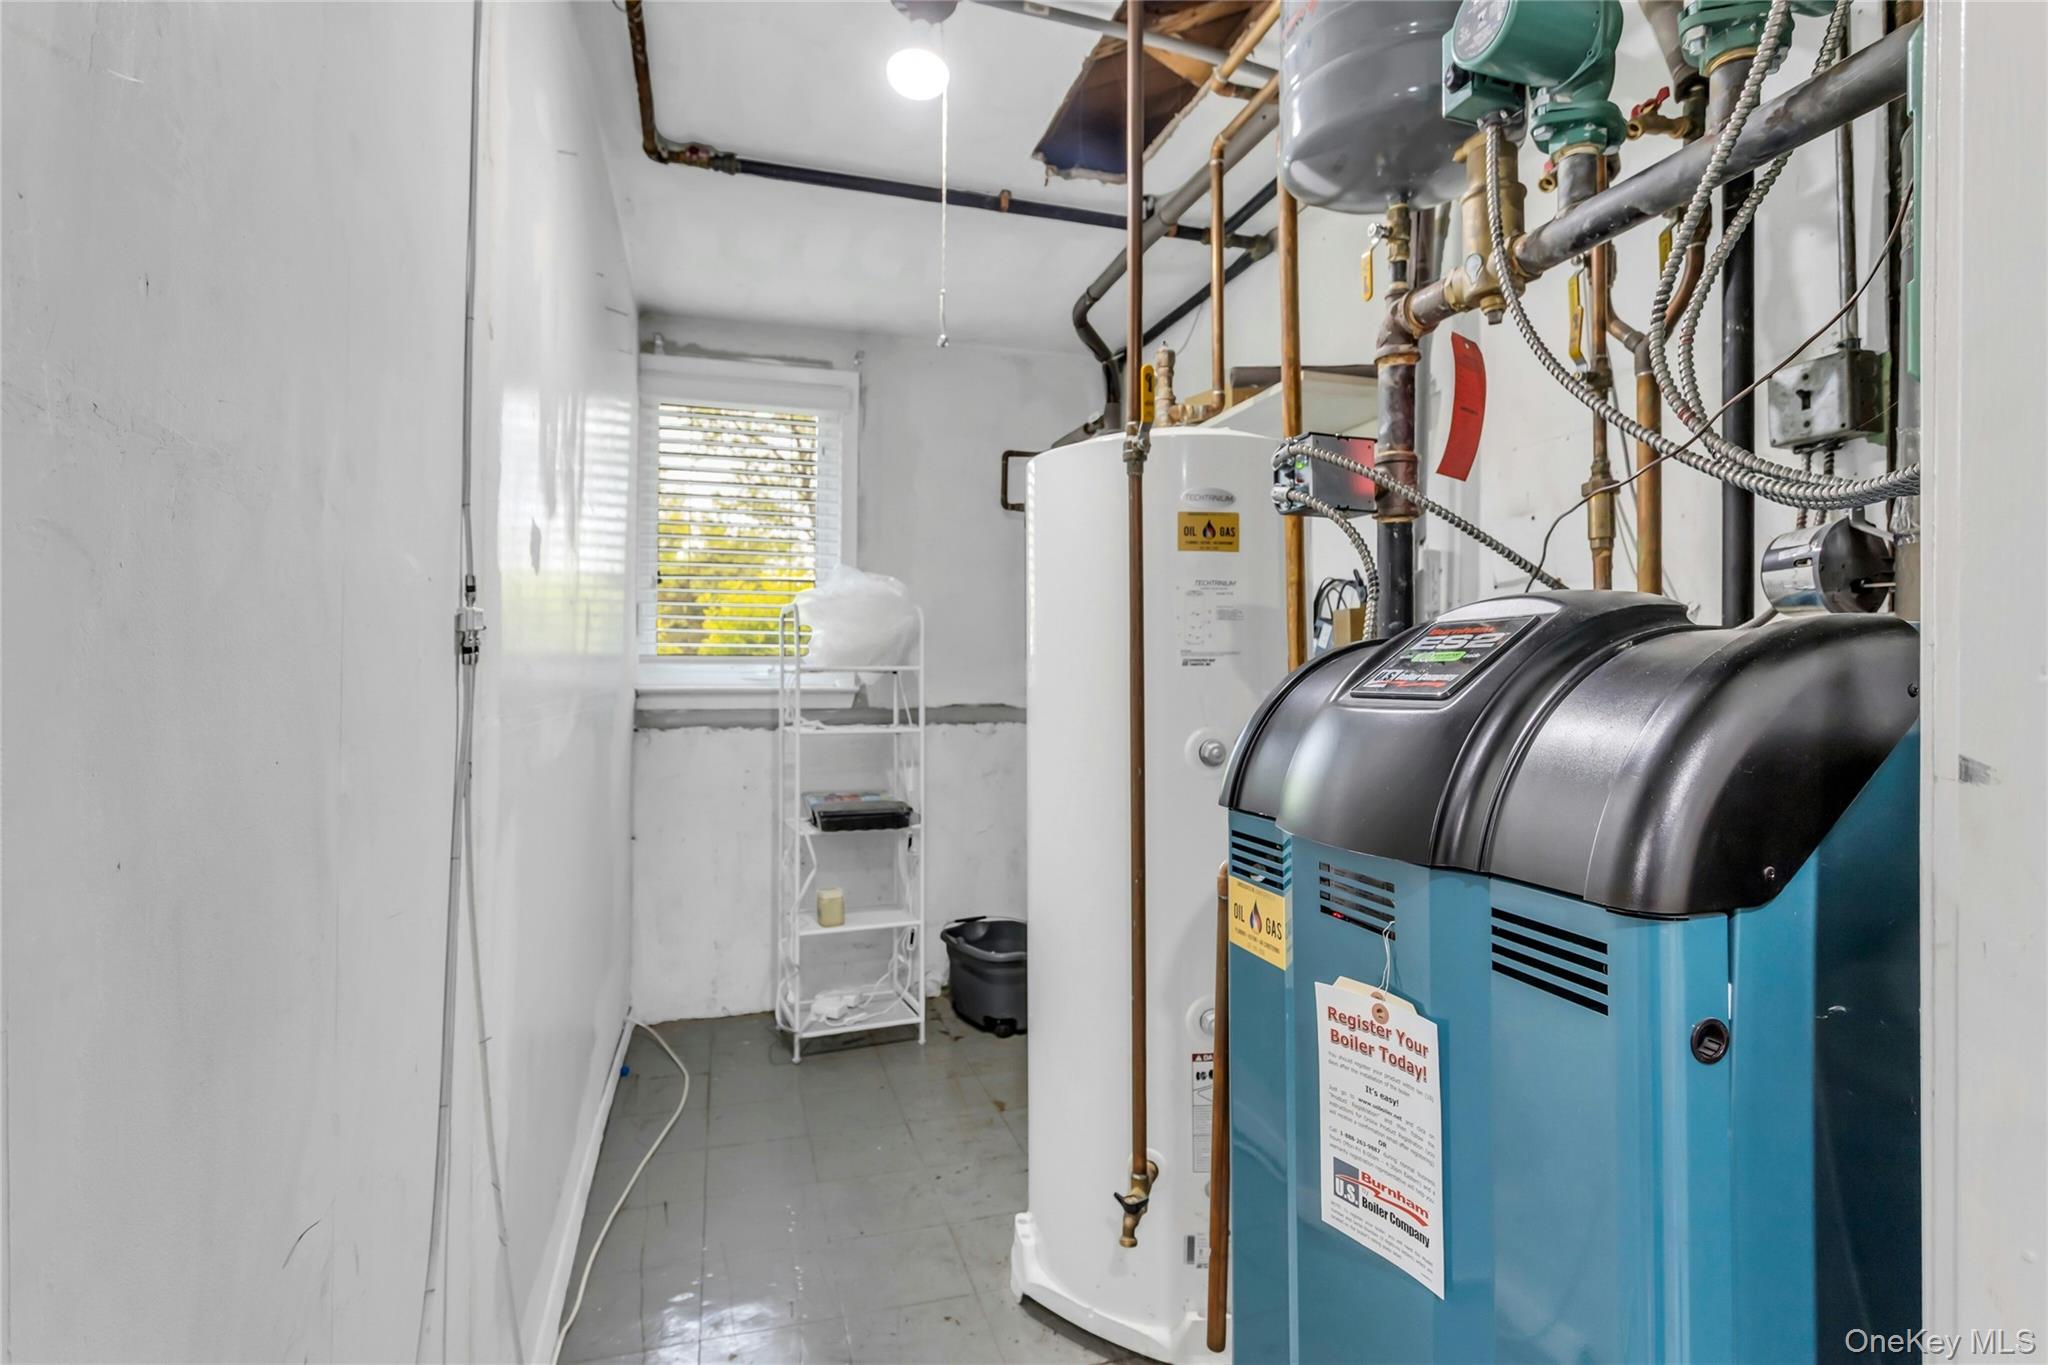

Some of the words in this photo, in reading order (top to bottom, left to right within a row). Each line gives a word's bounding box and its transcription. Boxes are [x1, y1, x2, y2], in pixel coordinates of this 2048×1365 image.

[1183, 526, 1197, 537] OIL
[1219, 526, 1236, 538] GAS
[1410, 632, 1506, 651] ES2
[1233, 902, 1245, 923] OIL
[1265, 917, 1283, 941] GAS
[1328, 1006, 1392, 1039] Register
[1396, 1029, 1429, 1059] Your
[1330, 1028, 1375, 1058] Boiler
[1379, 1045, 1428, 1083] Today!
[1365, 1085, 1378, 1097] It's
[1380, 1093, 1399, 1107] easy!
[1378, 1139, 1387, 1149] OR
[1335, 1177, 1359, 1206] U.S.
[1362, 1196, 1388, 1221] Boiler
[1390, 1211, 1430, 1249] Company
[1361, 1171, 1430, 1219] Burnham
